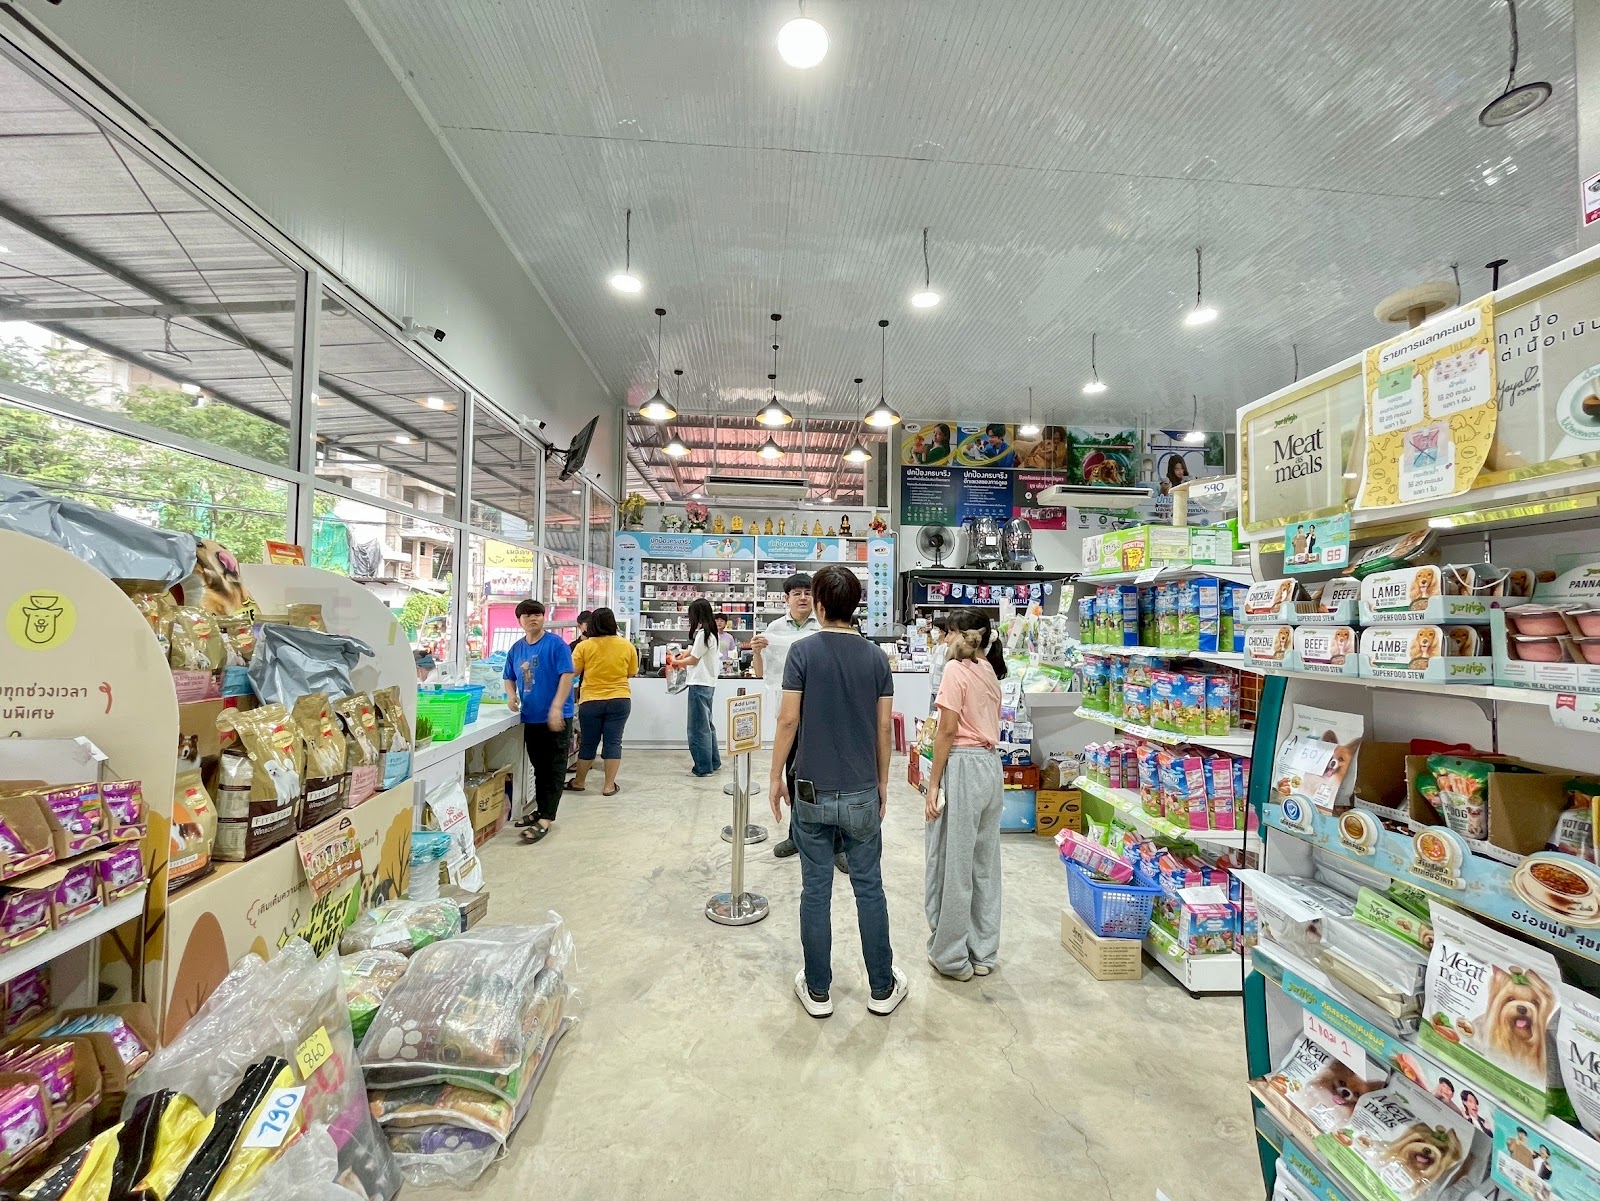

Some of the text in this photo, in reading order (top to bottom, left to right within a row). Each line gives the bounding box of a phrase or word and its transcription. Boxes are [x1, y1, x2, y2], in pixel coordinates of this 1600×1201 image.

[1383, 317, 1476, 363] รายการแลกคะแนน
[1273, 429, 1324, 465] Meat
[1295, 456, 1304, 464] as
[1275, 455, 1323, 484] meals
[1204, 482, 1224, 493] 590
[1249, 591, 1270, 602] CHICKEN
[1332, 589, 1352, 601] BEEF
[1372, 584, 1401, 599] LAMB
[1373, 613, 1425, 622] SUPERFOOD STEW
[1248, 637, 1270, 648] CHICKEN
[1304, 638, 1323, 649] BEEF
[1371, 640, 1401, 652] LAMB
[1303, 664, 1343, 674] SUPERFOOD STEW
[1372, 669, 1425, 680] SUPERFOOD STEW
[1531, 682, 1548, 690] REAL
[1548, 683, 1577, 692] CHICKEN
[311, 891, 332, 923] THE
[1439, 944, 1487, 984] Meat
[303, 1043, 326, 1069] 860
[1363, 1101, 1398, 1129] meals
[1371, 1094, 1414, 1125] Meat
[257, 1093, 297, 1140] 790
